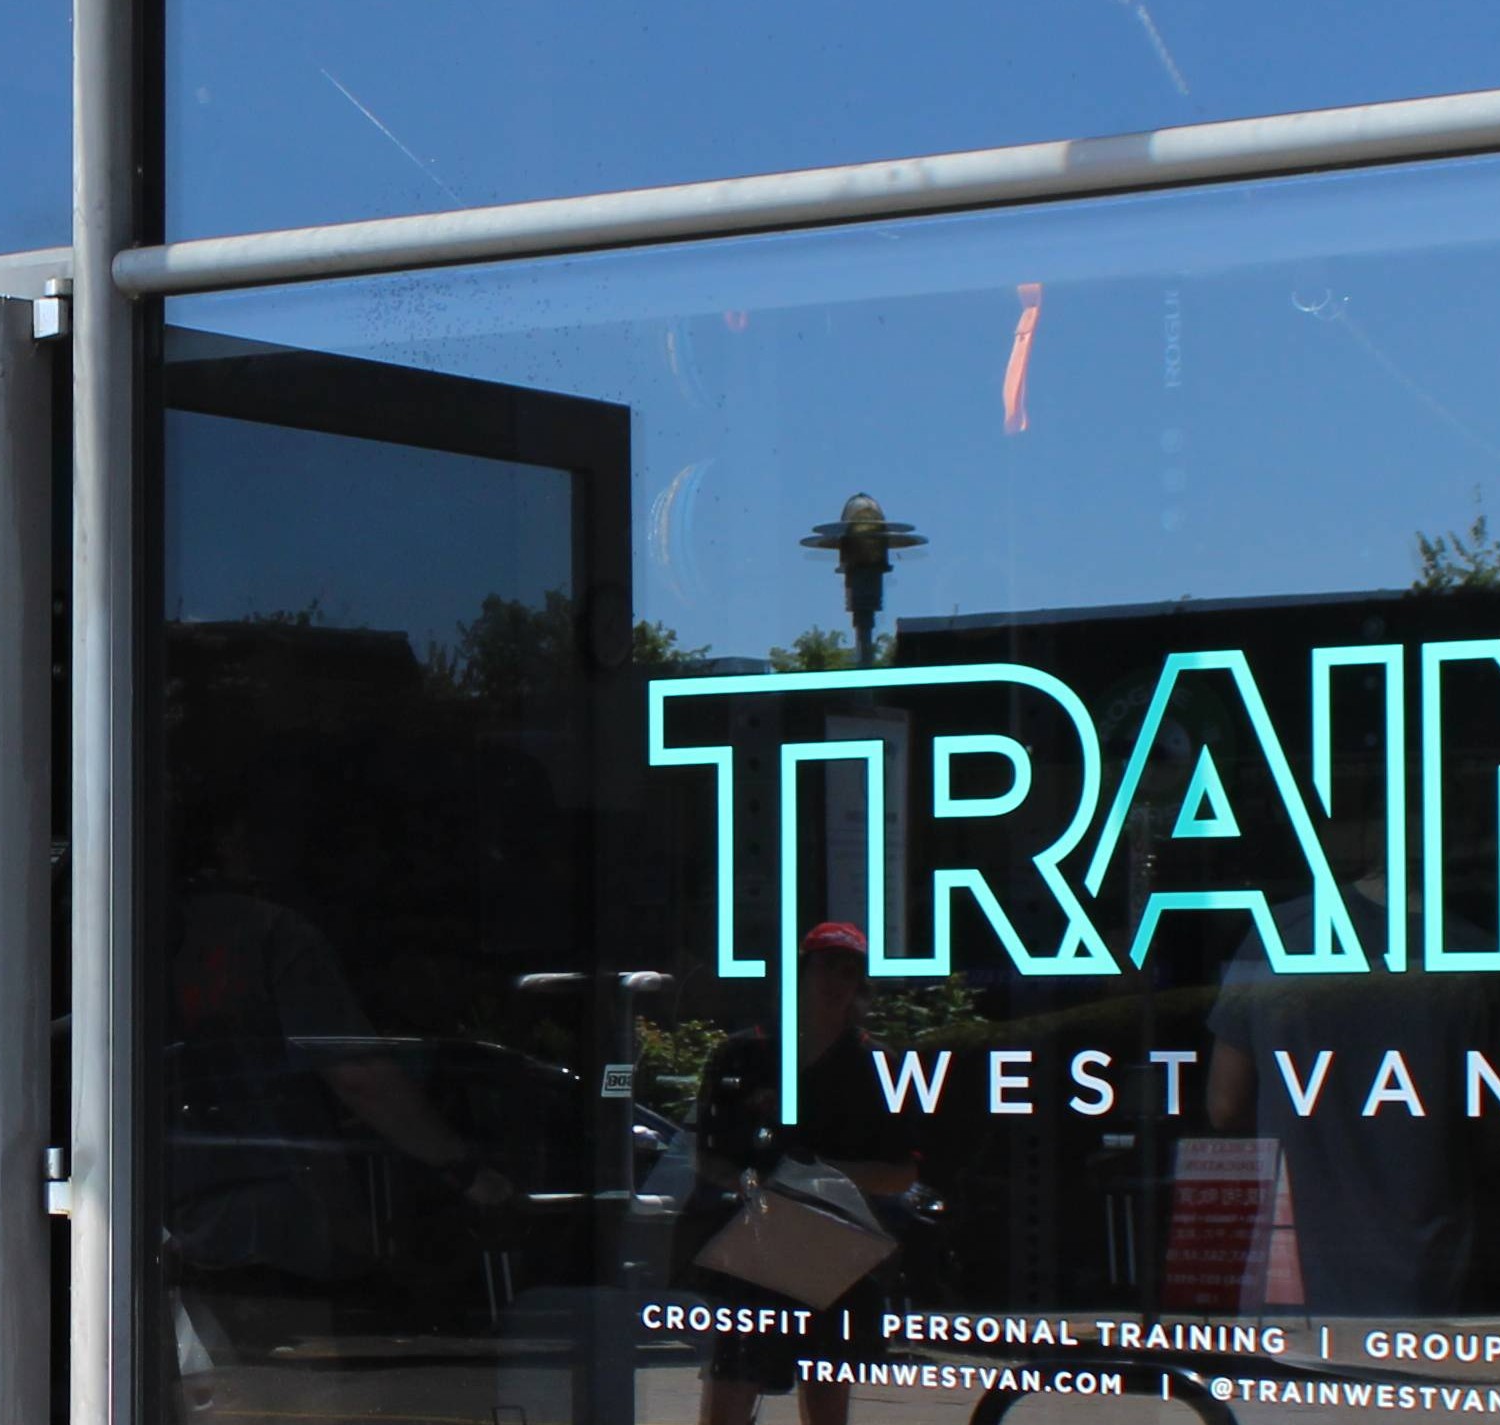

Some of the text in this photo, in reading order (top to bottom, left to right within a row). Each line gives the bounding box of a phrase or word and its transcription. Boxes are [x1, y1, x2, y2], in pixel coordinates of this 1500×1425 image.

[872, 1049, 1198, 1119] WEST
[642, 1303, 812, 1338] CROSSFIT
[881, 1314, 1083, 1351] PERSONAL
[1094, 1321, 1286, 1356] TRAINING
[797, 1358, 1123, 1395] TRAINWESTVAN.COM
